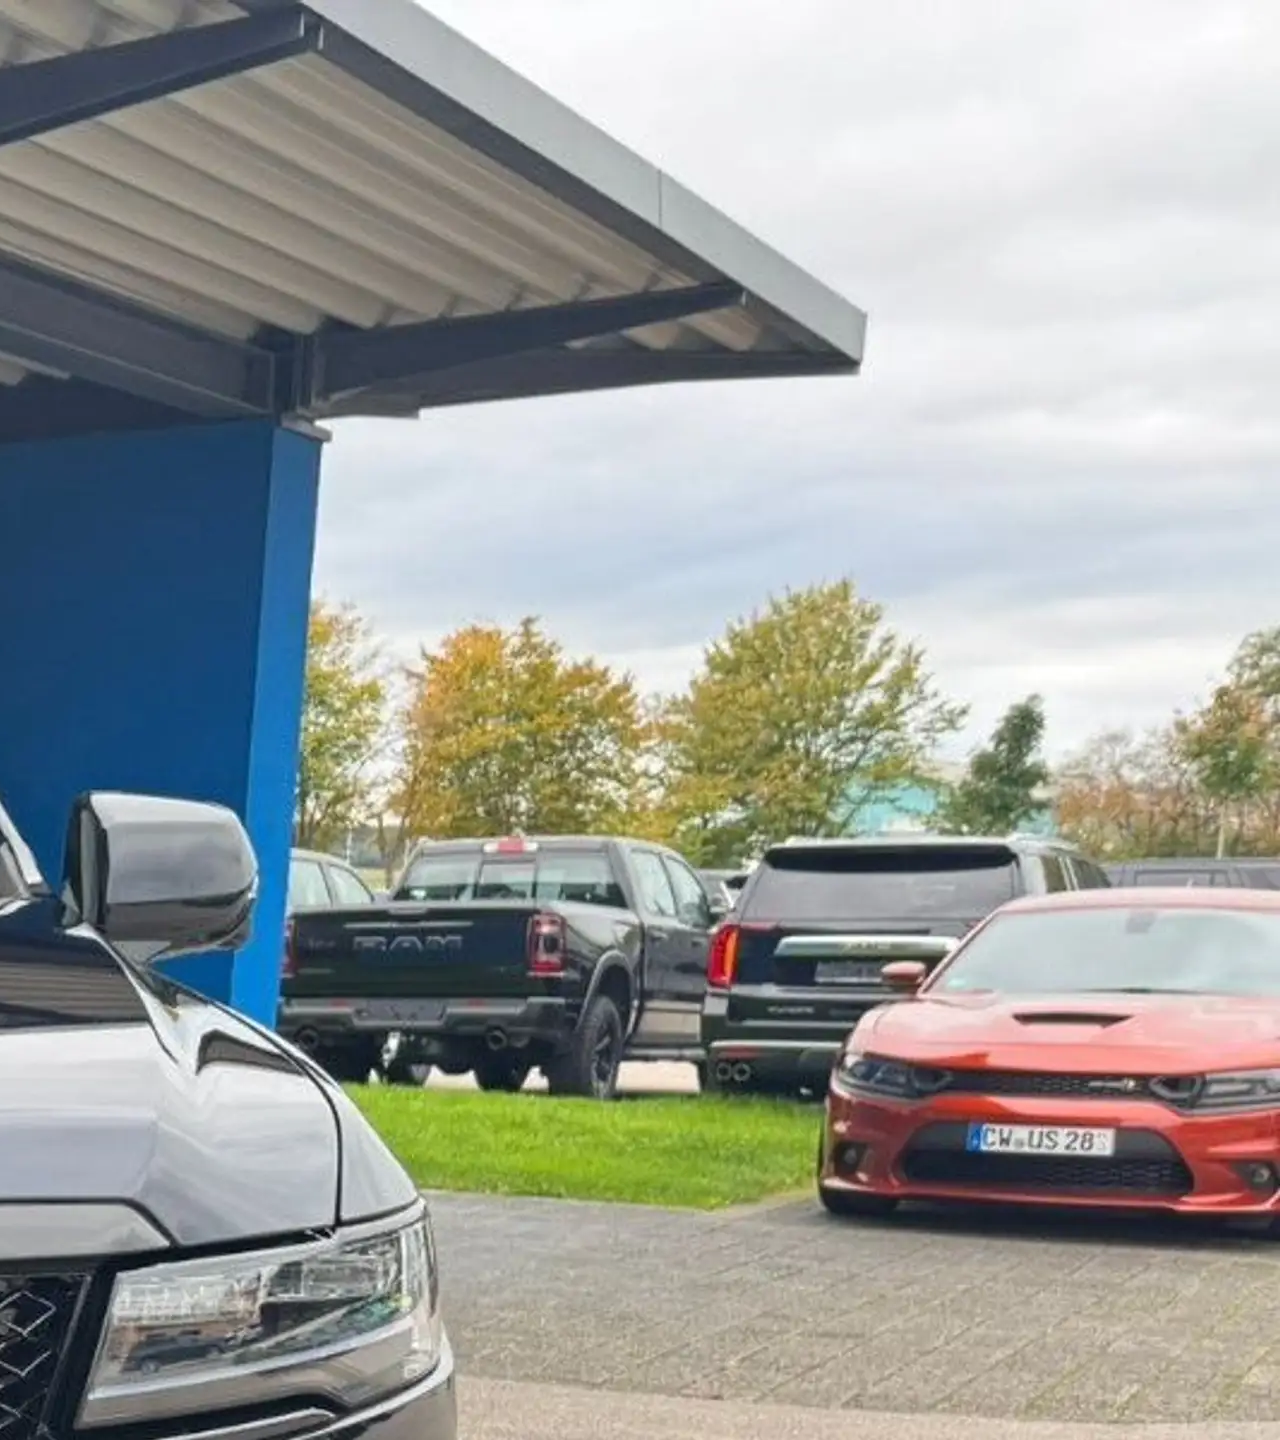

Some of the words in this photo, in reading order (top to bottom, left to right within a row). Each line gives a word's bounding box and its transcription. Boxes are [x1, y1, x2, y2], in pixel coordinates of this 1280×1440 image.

[351, 934, 463, 956] RAM
[982, 1127, 1013, 1148] CW
[1027, 1129, 1059, 1150] US
[1063, 1130, 1094, 1152] 28
